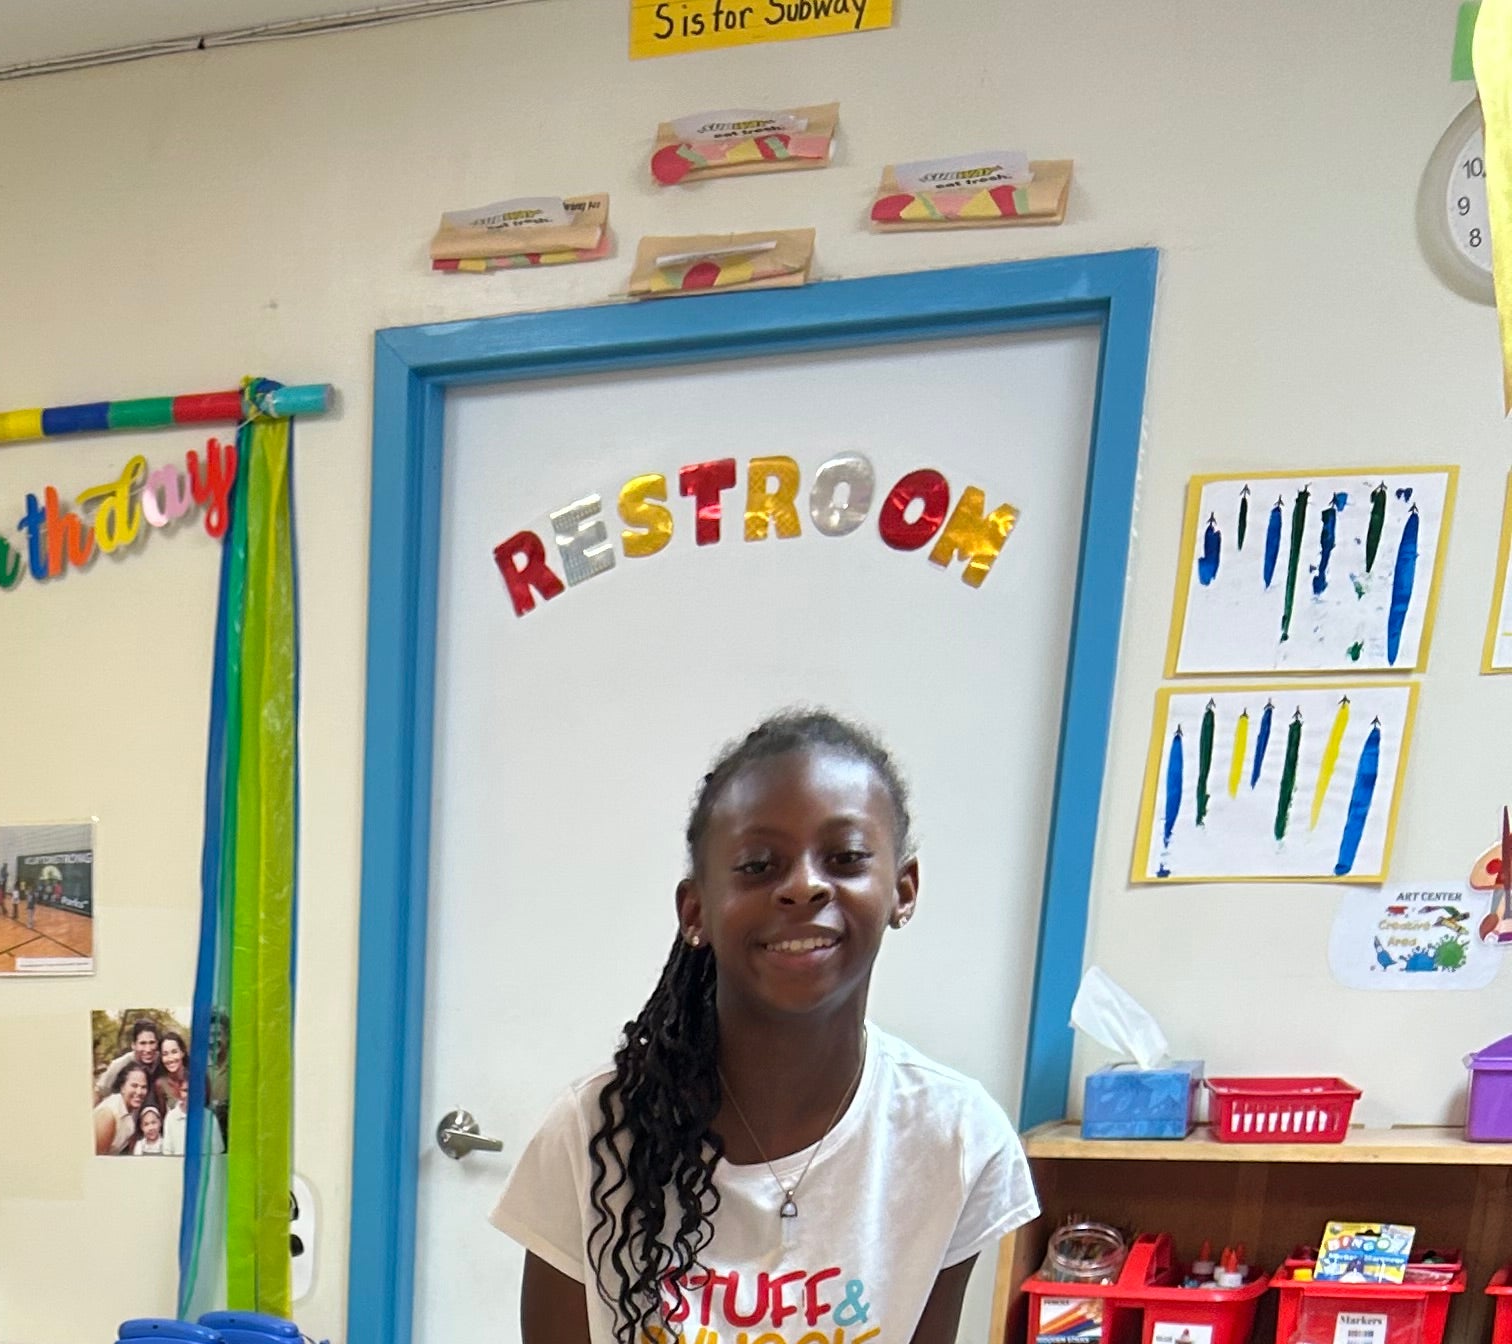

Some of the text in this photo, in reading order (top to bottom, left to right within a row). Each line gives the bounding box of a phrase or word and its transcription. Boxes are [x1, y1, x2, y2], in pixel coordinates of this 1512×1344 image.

[654, 0, 867, 39] S is for Subway
[1462, 157, 1484, 179] 10
[1457, 196, 1470, 216] 9
[1469, 228, 1482, 247] 8
[493, 450, 1021, 619] RESTROOM
[1396, 891, 1463, 902] ART CENTER
[660, 1266, 871, 1329] STUFF&
[1340, 1314, 1383, 1326] Markers
